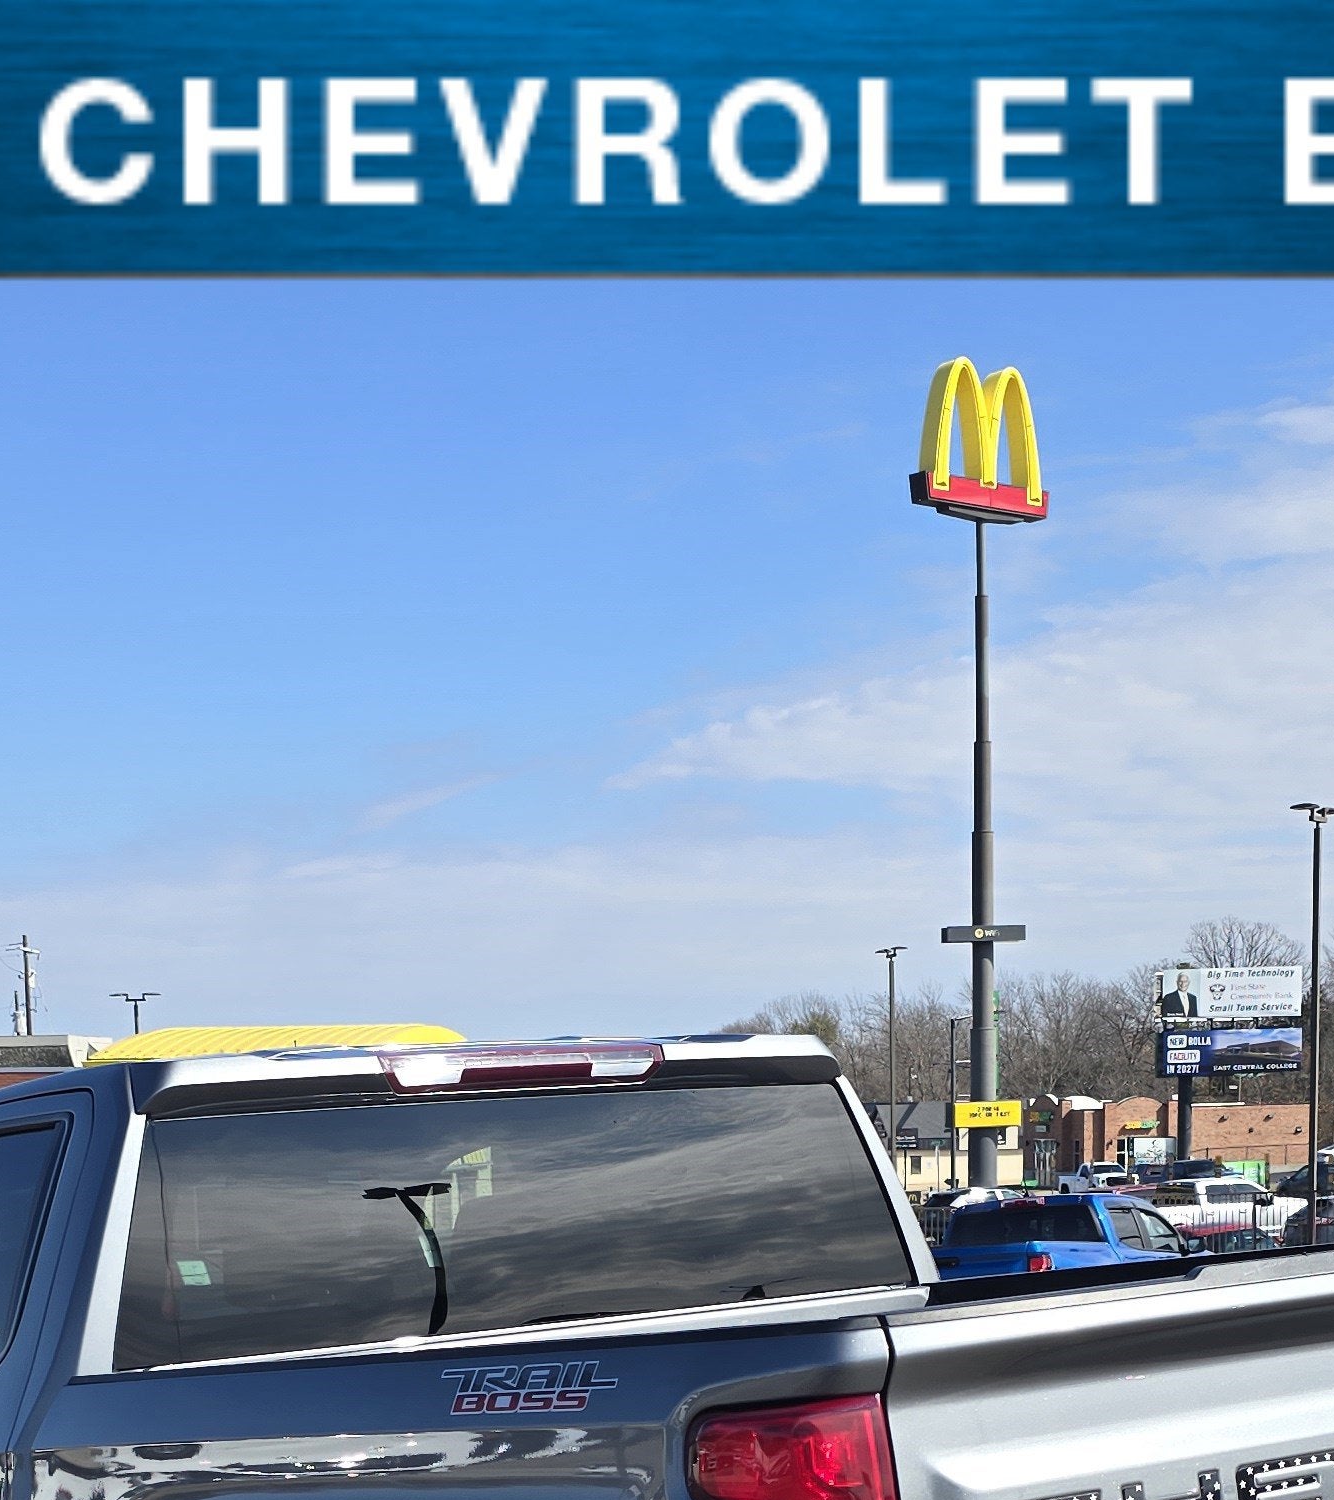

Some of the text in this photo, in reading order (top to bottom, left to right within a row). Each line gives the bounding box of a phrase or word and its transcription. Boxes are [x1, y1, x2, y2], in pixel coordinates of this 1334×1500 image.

[1225, 970, 1244, 978] Time
[1248, 969, 1295, 978] Technology
[1209, 1005, 1233, 1013] Small
[1236, 1004, 1258, 1012] Town
[1261, 1003, 1293, 1011] Service
[1170, 1038, 1185, 1046] NEW
[441, 1361, 618, 1394] TRAIL
[450, 1389, 591, 1415] BOSS
